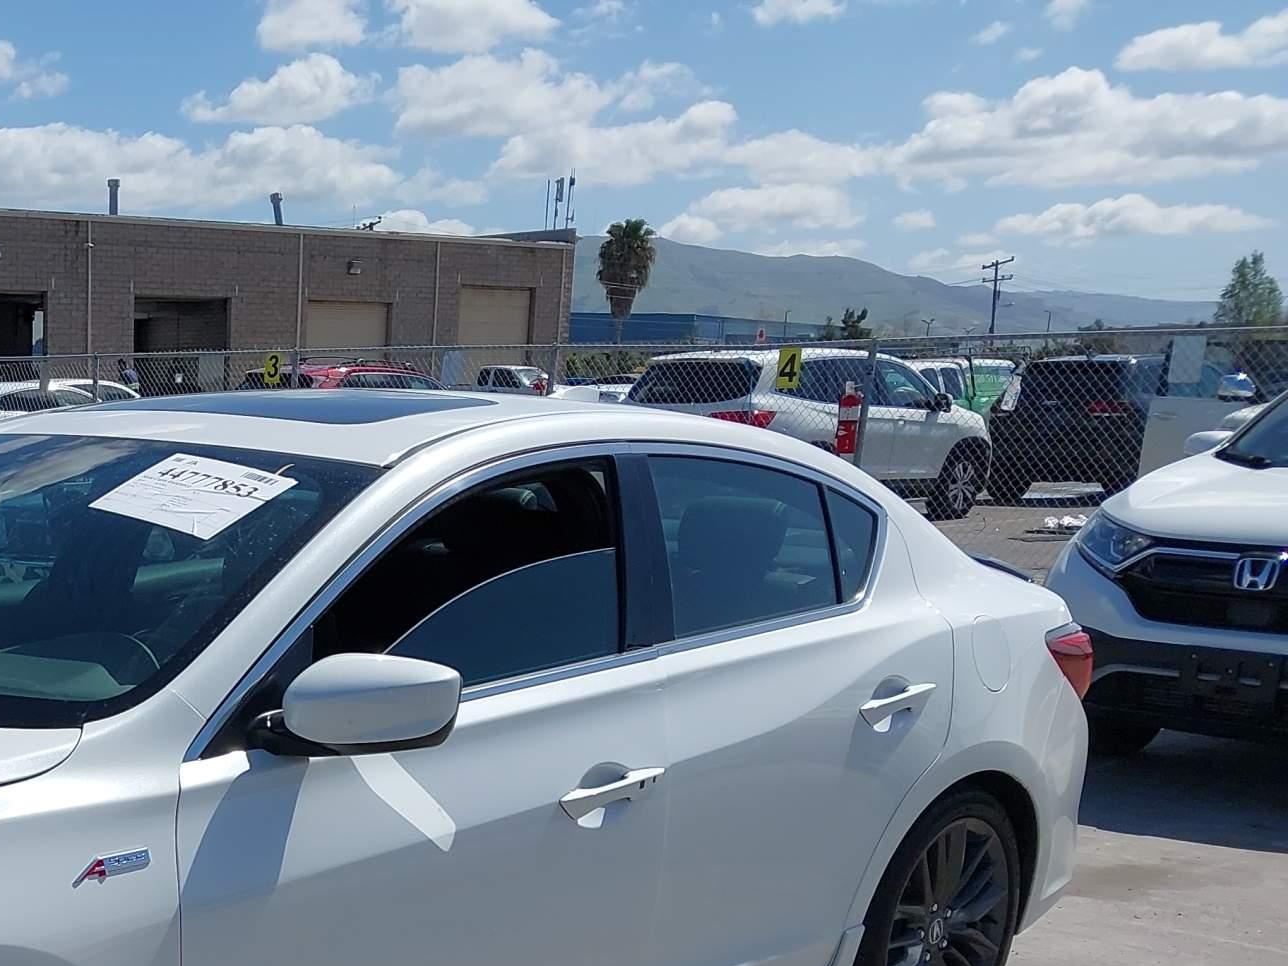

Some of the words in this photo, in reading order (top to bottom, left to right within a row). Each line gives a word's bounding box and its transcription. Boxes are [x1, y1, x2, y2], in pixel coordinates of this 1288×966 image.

[267, 354, 279, 379] 3
[778, 352, 798, 383] 4
[157, 466, 259, 498] 44777853
